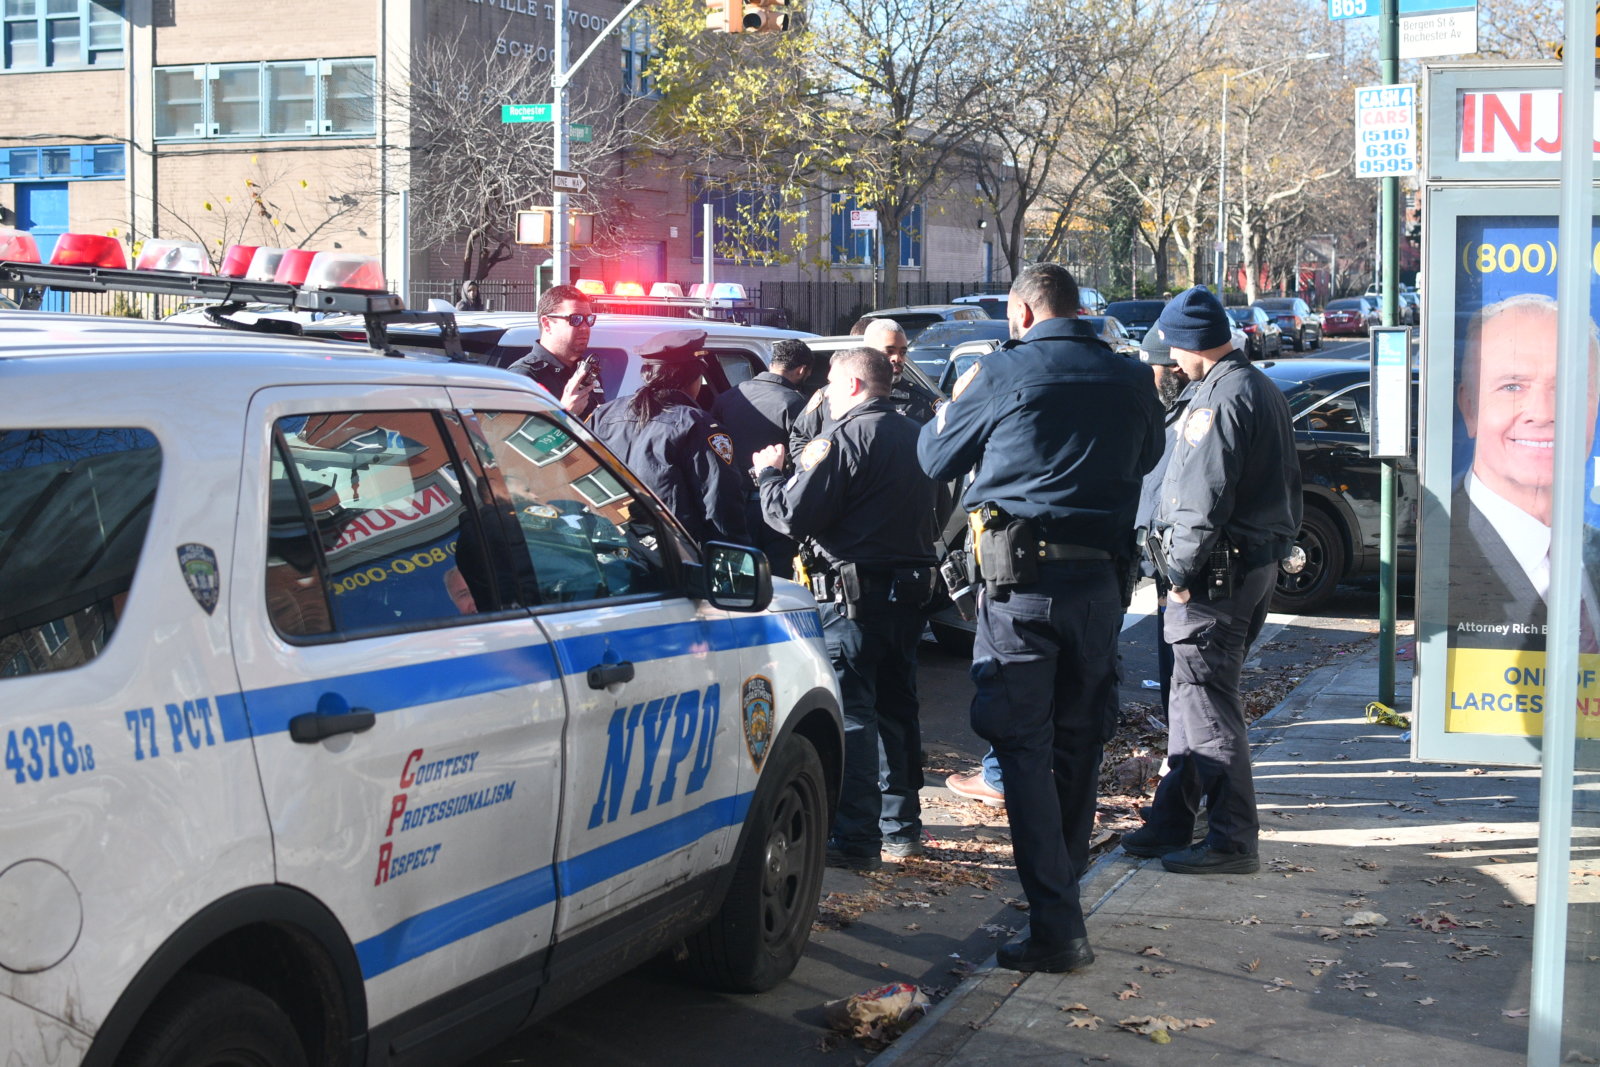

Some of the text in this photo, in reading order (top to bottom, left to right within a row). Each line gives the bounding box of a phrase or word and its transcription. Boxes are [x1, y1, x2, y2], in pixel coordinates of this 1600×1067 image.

[1331, 0, 1367, 17] B65
[1403, 16, 1456, 32] Bergen St &
[1403, 28, 1462, 43] Rochester Av
[1360, 87, 1413, 109] CASH 4
[509, 106, 546, 116] Rochester
[1363, 109, 1408, 125] CARS
[1461, 92, 1600, 154] INJ
[1362, 128, 1410, 143] (516)
[1366, 143, 1407, 158] 636
[1359, 158, 1413, 173] 9595
[556, 176, 568, 187] ONE
[1462, 240, 1558, 276] (800)
[1456, 621, 1510, 636] Attorney
[1512, 623, 1538, 635] Rich
[748, 679, 765, 689] POLICE
[1503, 666, 1546, 687] ON
[1450, 691, 1544, 714] LARGES
[124, 697, 216, 761] 77 PCT
[5, 721, 79, 784] 4378
[587, 683, 721, 830] NYPD
[399, 748, 480, 789] COURTESY
[385, 780, 516, 837] PROFESSIONALISM
[374, 841, 442, 887] RESPECT
